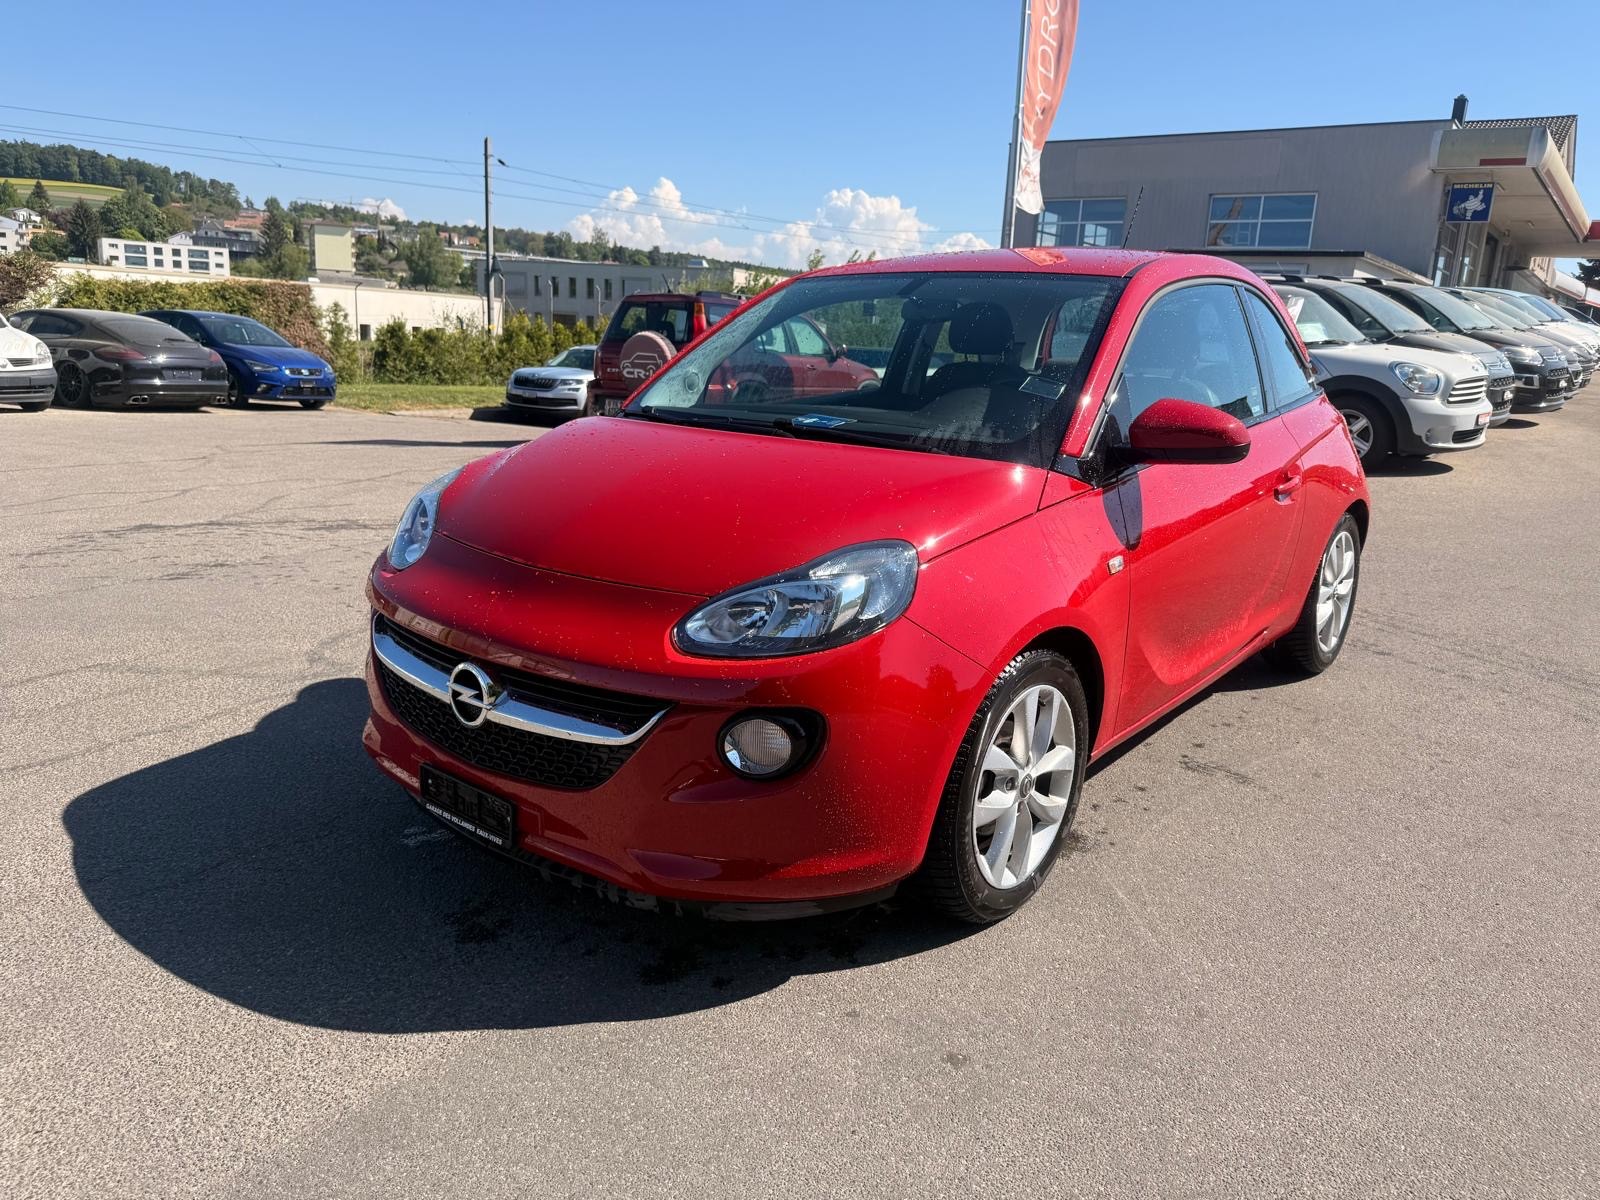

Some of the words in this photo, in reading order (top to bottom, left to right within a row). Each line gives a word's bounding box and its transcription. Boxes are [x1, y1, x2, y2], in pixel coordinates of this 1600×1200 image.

[425, 803, 443, 816] GARAGE
[442, 811, 451, 820] DES
[476, 828, 503, 845] EAUX-VIVES
